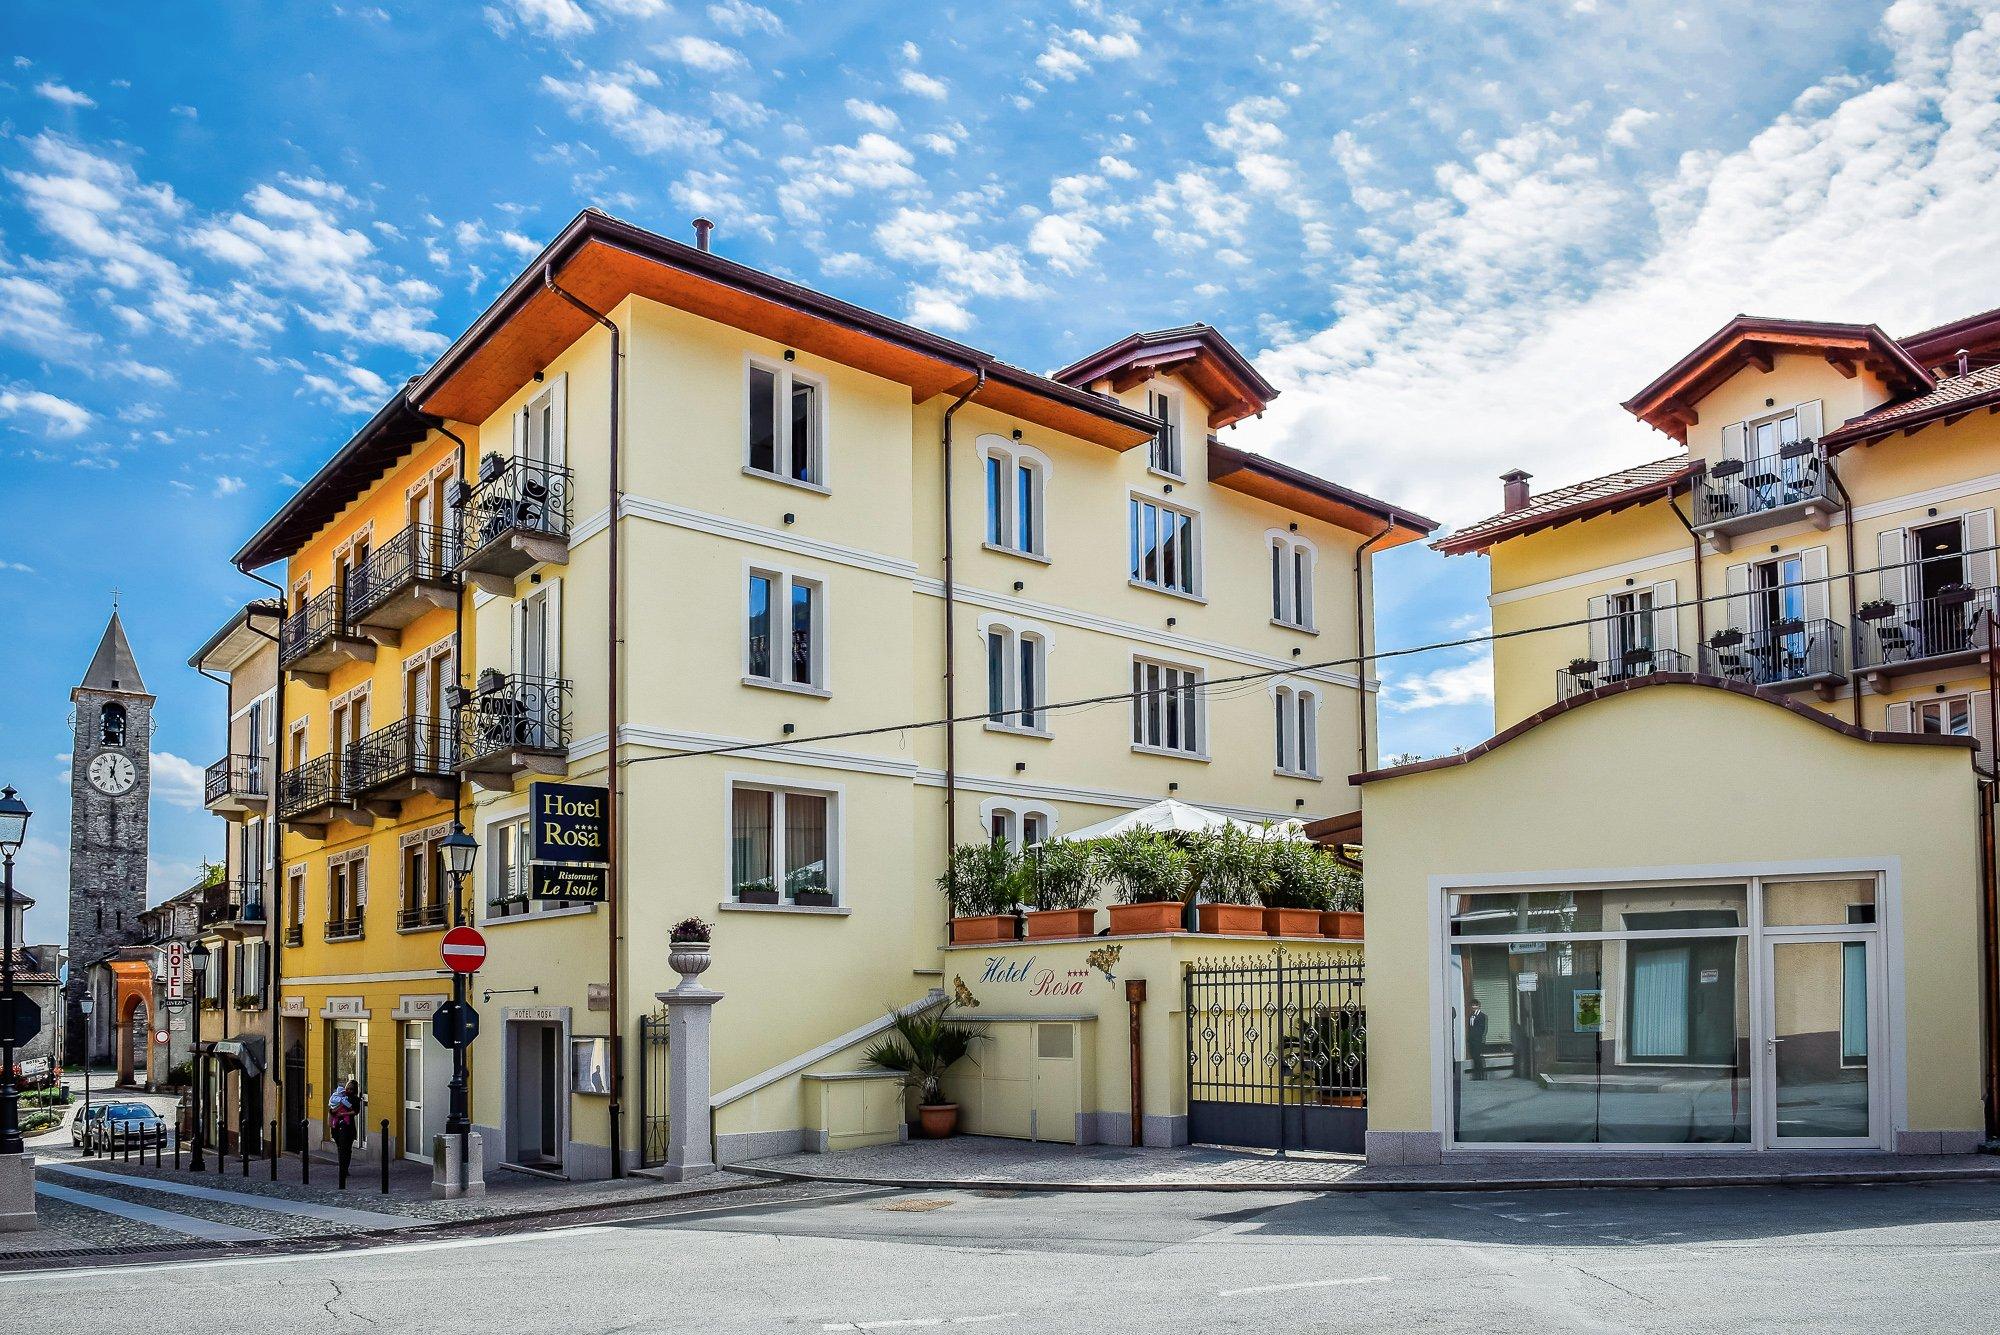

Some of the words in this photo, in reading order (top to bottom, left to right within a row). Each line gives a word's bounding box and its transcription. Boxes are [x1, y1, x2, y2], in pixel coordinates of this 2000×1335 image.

[544, 794, 600, 818] Hotel
[544, 822, 601, 847] Rosa
[541, 880, 560, 895] Le
[565, 881, 598, 896] Isole
[558, 871, 598, 881] Ristorante
[170, 945, 181, 998] HOTEL
[980, 956, 1036, 983] Hotel
[1029, 969, 1084, 997] Rosa
[515, 1010, 532, 1019] HOTEL
[537, 1010, 552, 1019] ROSA
